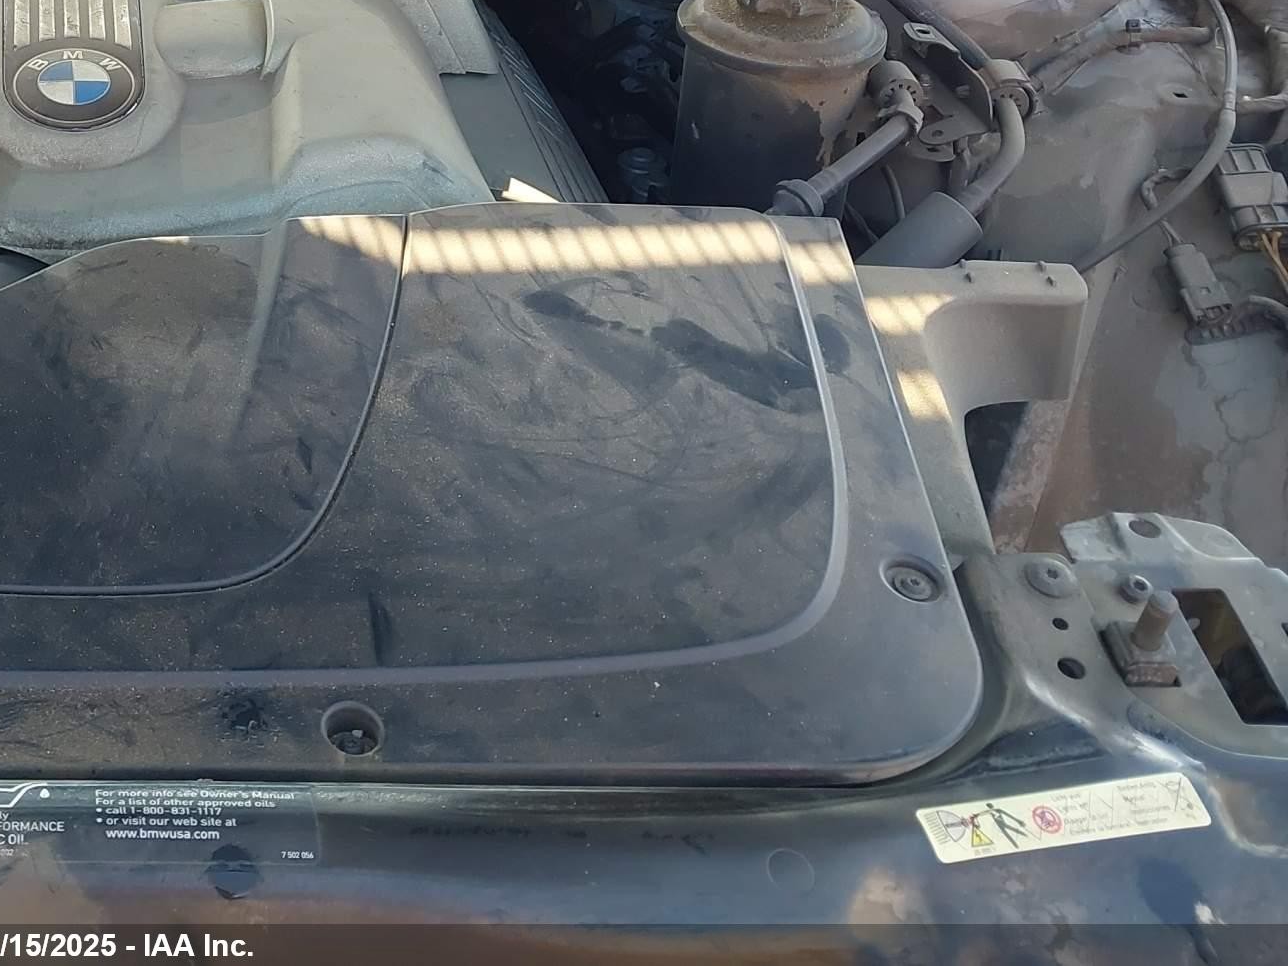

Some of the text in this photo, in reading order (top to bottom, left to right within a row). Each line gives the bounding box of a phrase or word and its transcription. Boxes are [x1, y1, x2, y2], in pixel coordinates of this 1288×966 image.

[27, 50, 122, 71] BMW
[95, 789, 115, 797] For
[152, 789, 173, 797] info
[176, 790, 197, 798] see
[200, 790, 249, 799] Owner's
[252, 791, 295, 800] Manual
[95, 798, 115, 806] For
[128, 798, 147, 806] list
[150, 798, 162, 806] of
[163, 798, 193, 806] other
[196, 798, 252, 808] approved
[254, 799, 276, 808] oils
[105, 807, 222, 815] call 1-800-831-1117
[106, 816, 237, 827] or visit our web site at
[7, 833, 30, 845] OIL
[105, 829, 220, 840] www.bmwusa.com
[281, 851, 287, 859] 7
